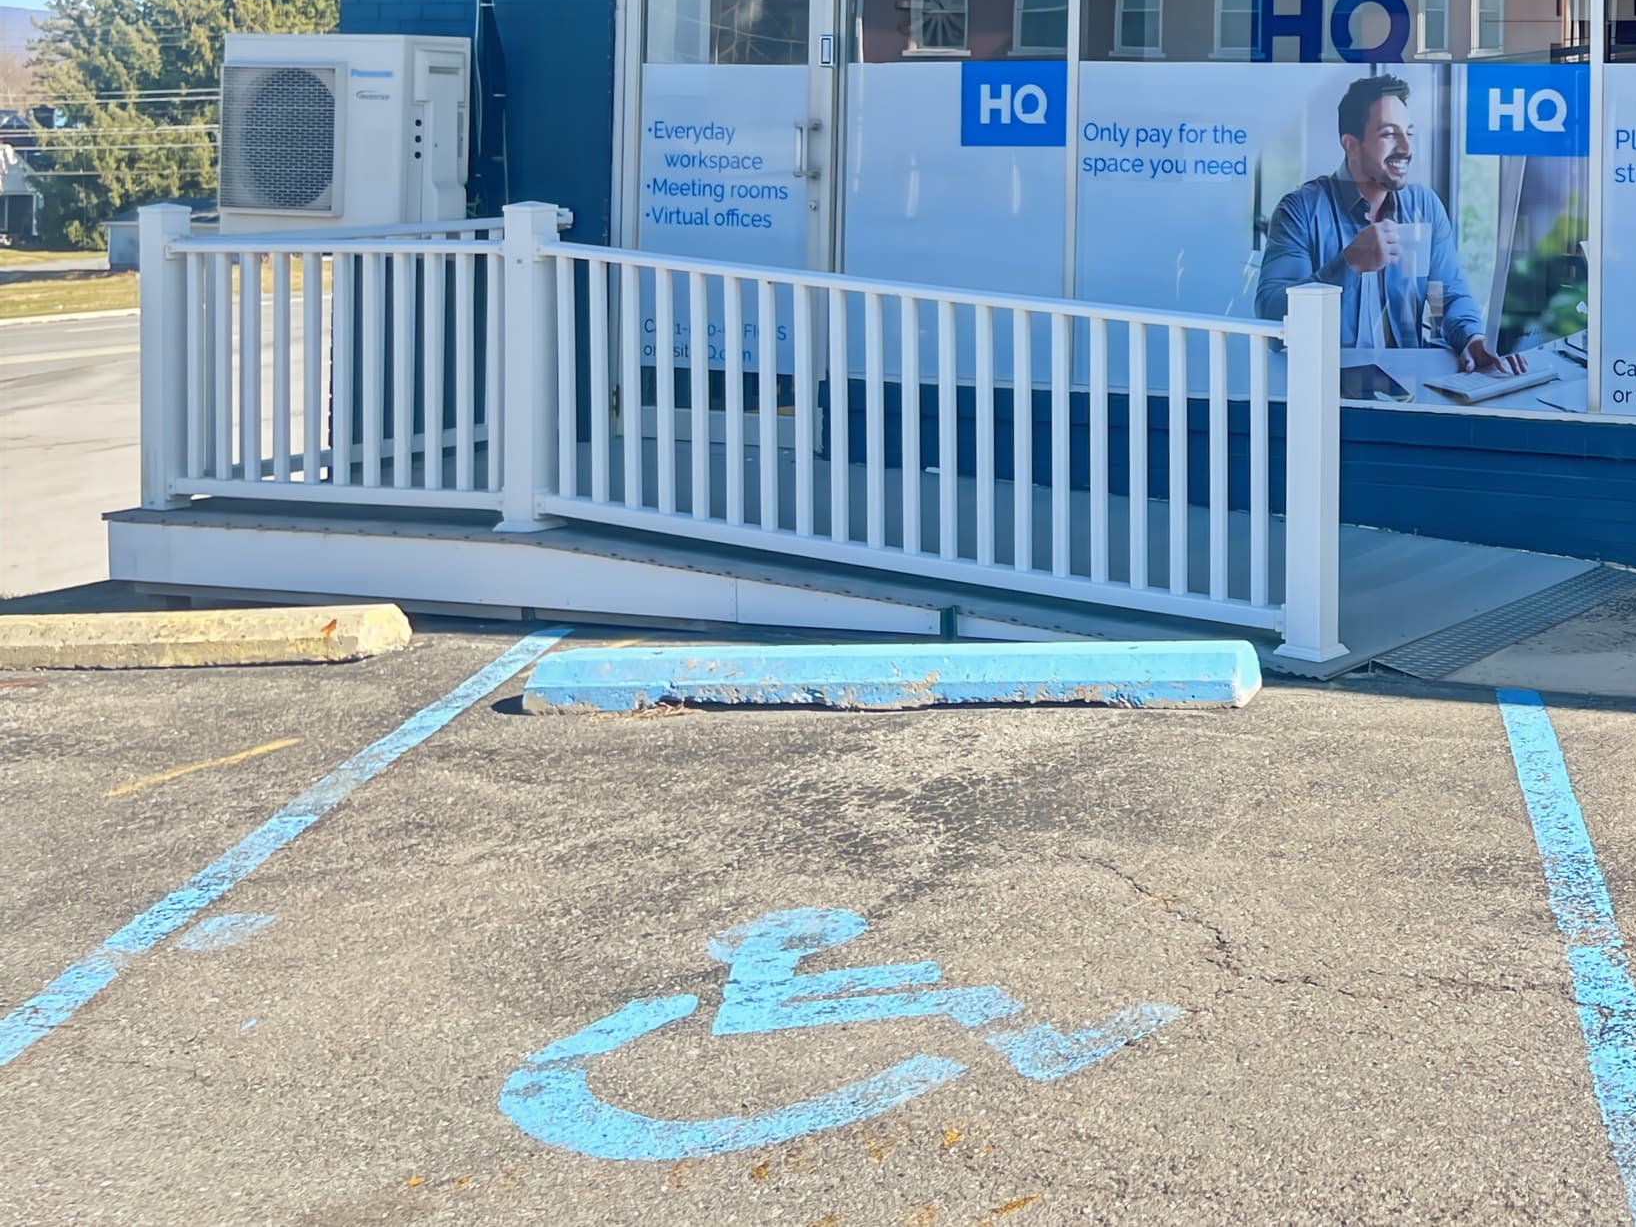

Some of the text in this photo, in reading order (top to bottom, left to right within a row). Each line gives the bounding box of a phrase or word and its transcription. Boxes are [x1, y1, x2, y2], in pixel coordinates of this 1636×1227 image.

[979, 84, 1048, 124] HQ
[1488, 88, 1568, 132] HQ
[654, 121, 735, 145] Everyday
[1083, 122, 1247, 148] Only pay for the
[664, 150, 763, 173] workspace
[1082, 155, 1247, 179] space you need
[652, 178, 789, 202] Meeting rooms
[651, 206, 773, 228] Virtual offices
[1613, 389, 1632, 404] or
